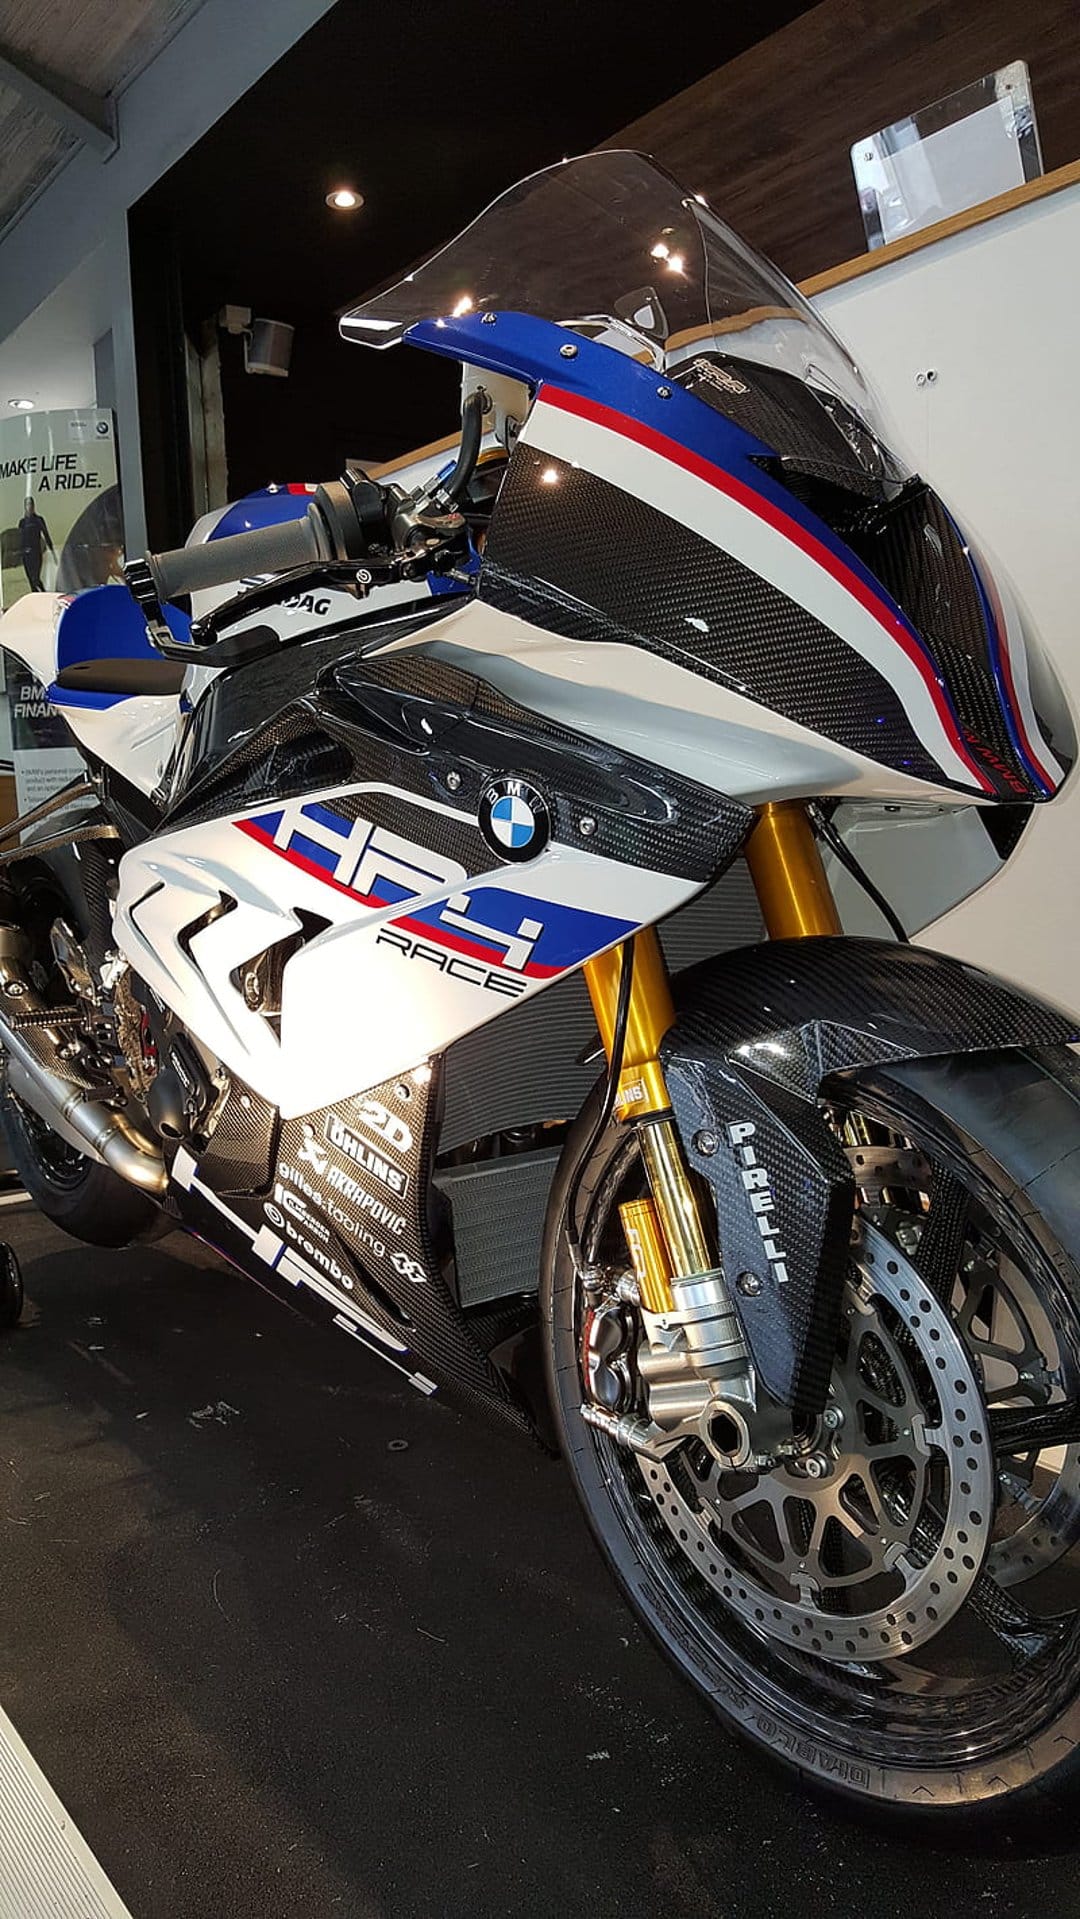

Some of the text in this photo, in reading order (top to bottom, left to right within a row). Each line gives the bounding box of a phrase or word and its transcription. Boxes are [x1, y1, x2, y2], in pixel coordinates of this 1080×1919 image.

[0, 453, 78, 479] MAKE LIFE
[38, 472, 102, 492] A RIDE.
[20, 685, 45, 701] BM
[376, 927, 529, 998] RACE
[357, 1099, 413, 1153] 2D
[729, 1121, 789, 1283] PIRELLI
[286, 1221, 354, 1290] brembo
[757, 1713, 871, 1789] DIABLO
